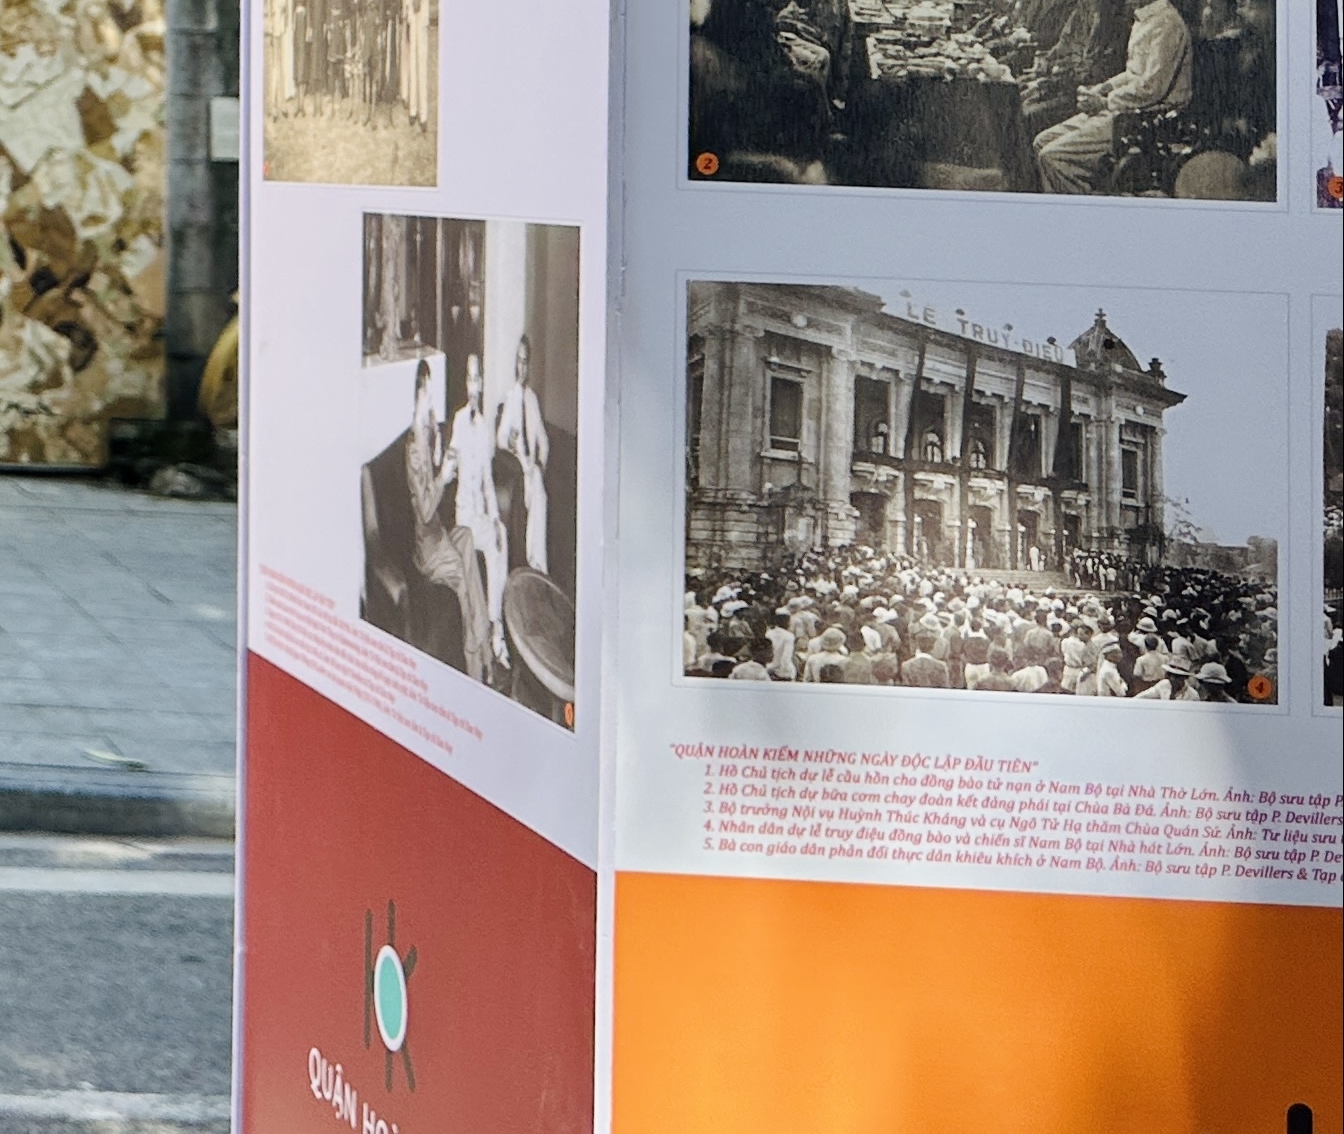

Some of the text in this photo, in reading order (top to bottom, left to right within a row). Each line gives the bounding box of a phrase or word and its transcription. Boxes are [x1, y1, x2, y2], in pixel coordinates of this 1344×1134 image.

[718, 743, 759, 760] HOÀN
[762, 744, 799, 762] KIẾM
[802, 749, 857, 765] NHỮNG
[860, 751, 899, 767] NGÀY
[901, 752, 931, 770] ĐỘC
[934, 754, 962, 772] LẬP
[964, 755, 994, 772] ĐẦU
[704, 763, 714, 777] 1.
[719, 764, 738, 778] Hồ
[742, 765, 766, 779] Chủ
[771, 766, 795, 783] tịch
[800, 768, 818, 785] dự
[836, 770, 860, 784] cầu
[864, 771, 889, 785] hồn
[893, 773, 917, 787] cho
[920, 774, 954, 793] đồng
[958, 775, 983, 790] bào
[1006, 781, 1032, 795] nạn
[1048, 780, 1080, 795] Nam
[1084, 782, 1102, 799] Bộ
[1106, 783, 1124, 800] tại
[1128, 784, 1155, 799] Nhà
[1160, 785, 1187, 800] Thờ
[1191, 787, 1219, 802] Lớn.
[1259, 790, 1276, 808] Bộ
[1279, 795, 1304, 806] sưu
[1308, 793, 1330, 812] tập
[704, 781, 714, 795] 2.
[719, 782, 738, 796] Hồ
[742, 783, 766, 798] Chủ
[771, 785, 795, 802] tịch
[799, 786, 818, 804] dự
[852, 792, 880, 803] cơm
[884, 791, 916, 809] chay
[919, 792, 952, 807] đoàn
[957, 794, 978, 808] kết
[1019, 797, 1050, 815] phái
[1053, 799, 1072, 816] tại
[1075, 800, 1109, 815] Chùa
[1113, 802, 1130, 816] Bà
[1135, 803, 1156, 817] Đá.
[1195, 806, 1213, 823] Bộ
[1216, 810, 1241, 821] sưu
[1246, 808, 1267, 827] tập
[703, 800, 714, 814] 3.
[719, 801, 736, 818] Bộ
[792, 804, 815, 822] Nội
[819, 809, 834, 823] vụ
[887, 809, 920, 824] Thúc
[923, 811, 967, 830] Kháng
[971, 813, 986, 827] và
[990, 817, 1005, 831] cụ
[1009, 815, 1036, 833] Ngô
[1063, 818, 1082, 835] Hạ
[1086, 819, 1121, 834] thăm
[1125, 821, 1159, 836] Chùa
[1164, 823, 1198, 841] Quán
[1262, 828, 1281, 842] Tư
[1284, 829, 1308, 846] liệu
[1311, 833, 1336, 845] sưu
[704, 818, 714, 832] 4.
[718, 819, 754, 834] Nhân
[758, 821, 783, 836] dân
[787, 822, 806, 840] dự
[825, 824, 853, 843] truy
[856, 826, 885, 844] điệu
[888, 828, 922, 847] đồng
[926, 829, 951, 844] bào
[956, 831, 970, 845] và
[974, 833, 1010, 847] chiến
[1029, 835, 1060, 850] Nam
[1064, 836, 1082, 854] Bộ
[1086, 837, 1104, 855] tại
[1108, 839, 1135, 853] Nhà
[1140, 840, 1163, 855] hát
[1166, 842, 1195, 856] Lớn.
[1234, 845, 1251, 862] Bộ
[1255, 849, 1279, 861] sưu
[1284, 847, 1306, 866] tập
[703, 837, 714, 851] 5.
[719, 838, 736, 852] Bà
[740, 842, 763, 853] con
[766, 841, 796, 858] giáo
[800, 842, 825, 856] dân
[867, 845, 888, 860] đối
[892, 846, 923, 864] thực
[926, 848, 951, 863] dân
[956, 850, 992, 865] khiêu
[996, 852, 1032, 867] khích
[1050, 854, 1081, 869] Nam
[1145, 859, 1162, 877] Bộ
[1166, 864, 1190, 875] sưu
[1195, 862, 1217, 880] tập
[1235, 864, 1294, 880] Devillers
[1297, 867, 1307, 881] &
[1312, 867, 1336, 886] Tạp
